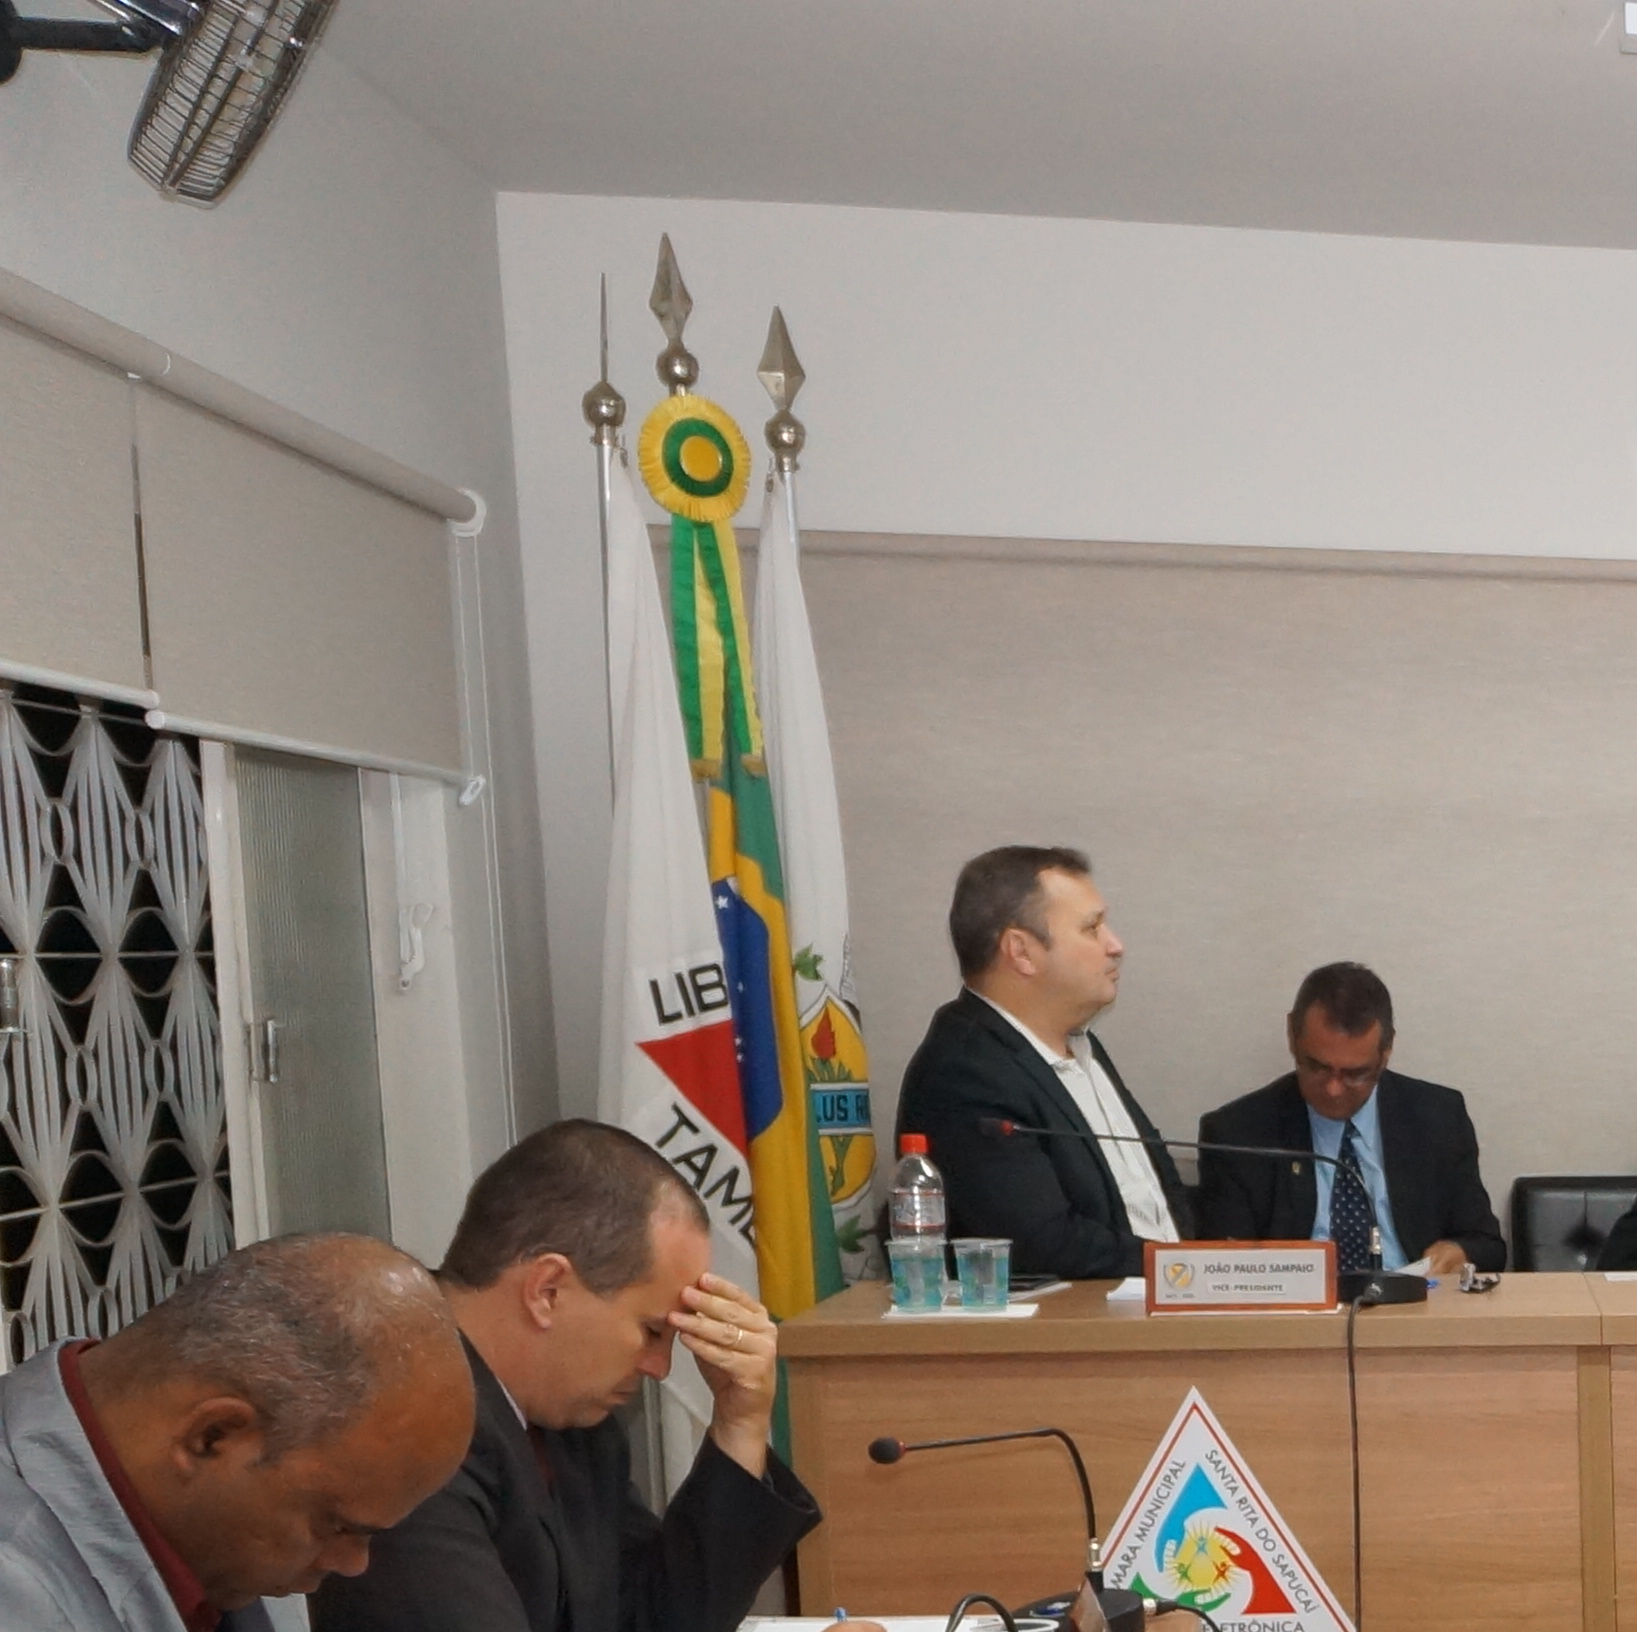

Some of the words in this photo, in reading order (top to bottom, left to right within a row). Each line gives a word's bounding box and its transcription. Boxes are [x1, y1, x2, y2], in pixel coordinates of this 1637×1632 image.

[1203, 1261, 1231, 1274] JOÃO
[1233, 1263, 1267, 1274] PAULO
[1268, 1263, 1315, 1274] SAMPAIO
[1134, 1460, 1187, 1544] MUNICIPAL
[1205, 1450, 1239, 1498] SANTA
[1236, 1495, 1258, 1529] RITA
[1255, 1528, 1277, 1553] DO
[1272, 1554, 1321, 1615] SAPUCAÍ
